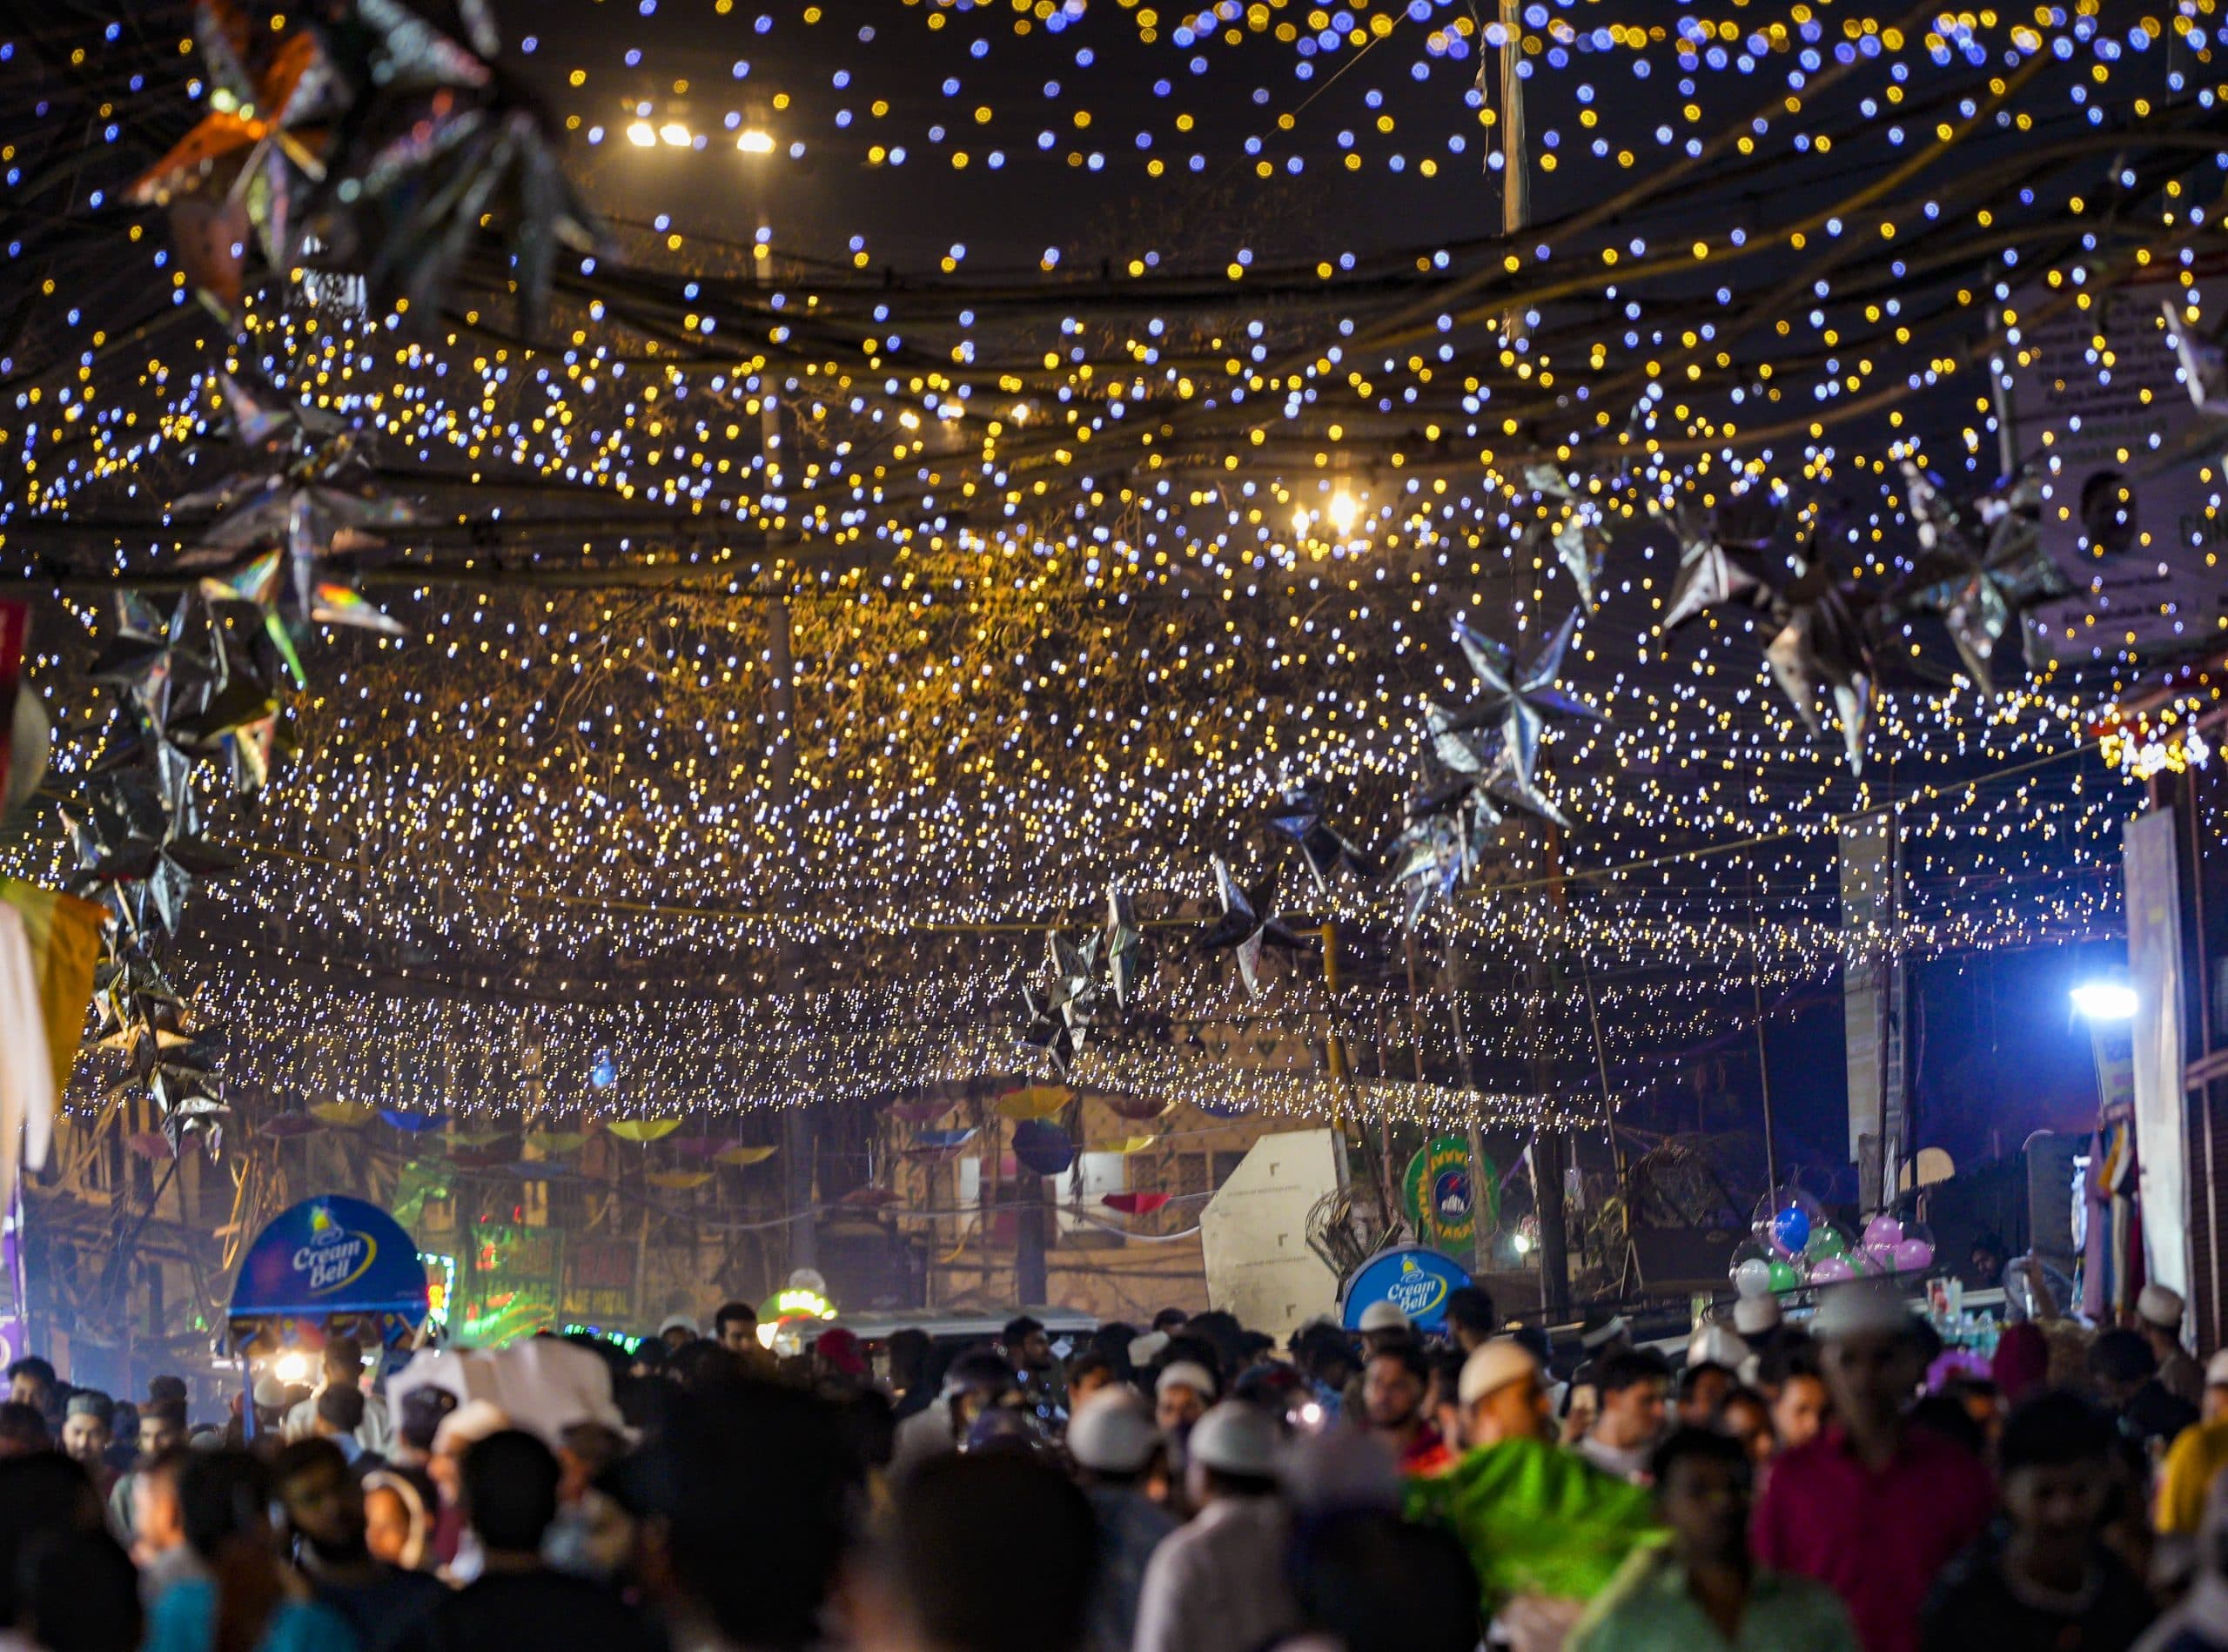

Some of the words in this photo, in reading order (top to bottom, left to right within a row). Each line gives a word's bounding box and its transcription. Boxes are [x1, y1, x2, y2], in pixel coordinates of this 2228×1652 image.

[292, 1239, 361, 1271] Cream
[311, 1259, 350, 1288] Bell
[1387, 1279, 1436, 1300] Cream
[1399, 1293, 1427, 1312] Bell
